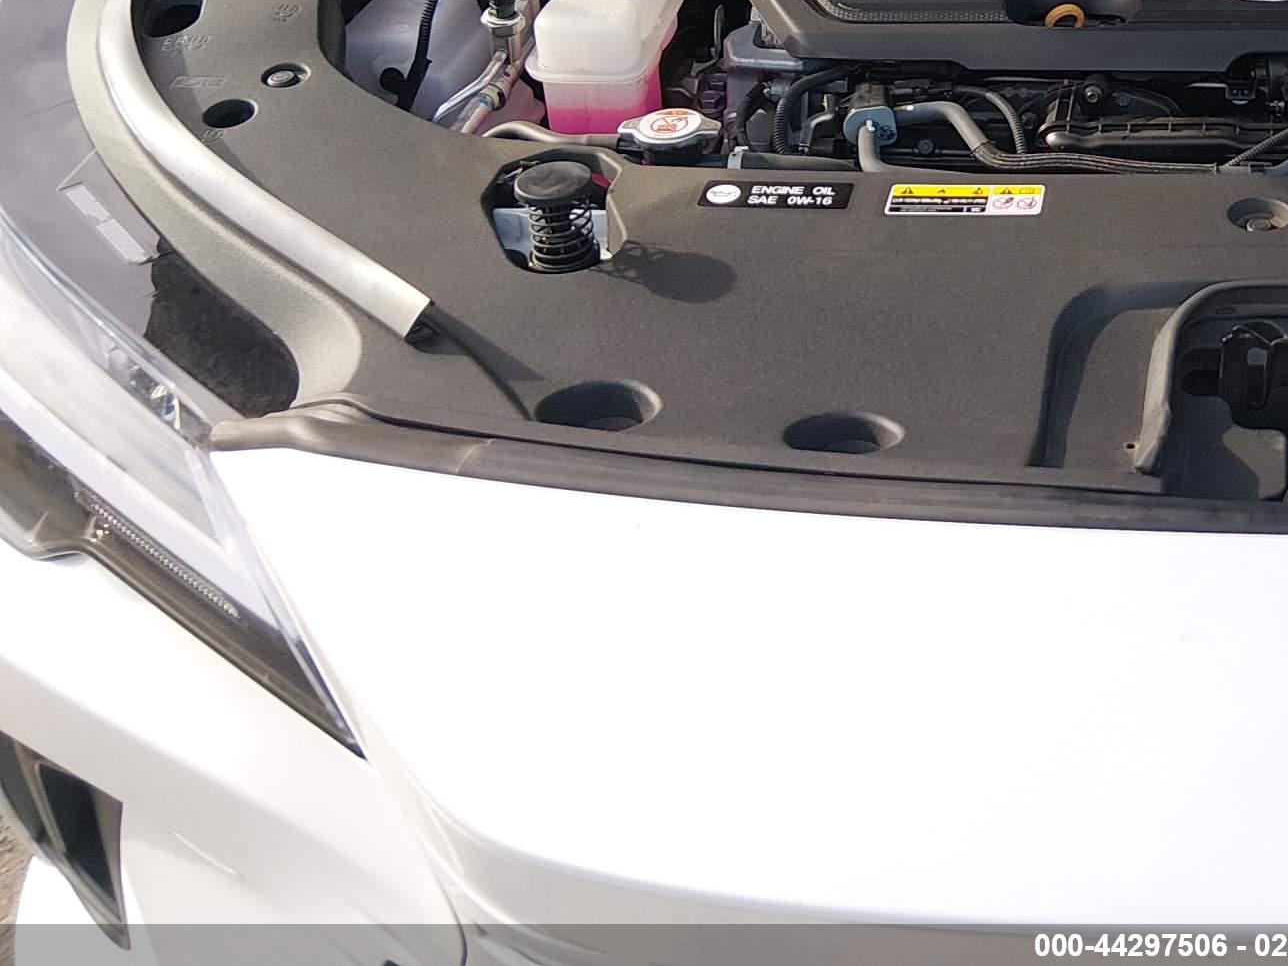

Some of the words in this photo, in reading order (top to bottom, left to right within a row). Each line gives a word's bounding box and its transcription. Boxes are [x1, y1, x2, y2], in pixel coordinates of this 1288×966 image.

[751, 185, 805, 195] ENGINE
[812, 186, 836, 195] OIL
[747, 195, 778, 204] SAE
[787, 196, 833, 205] 0W-16
